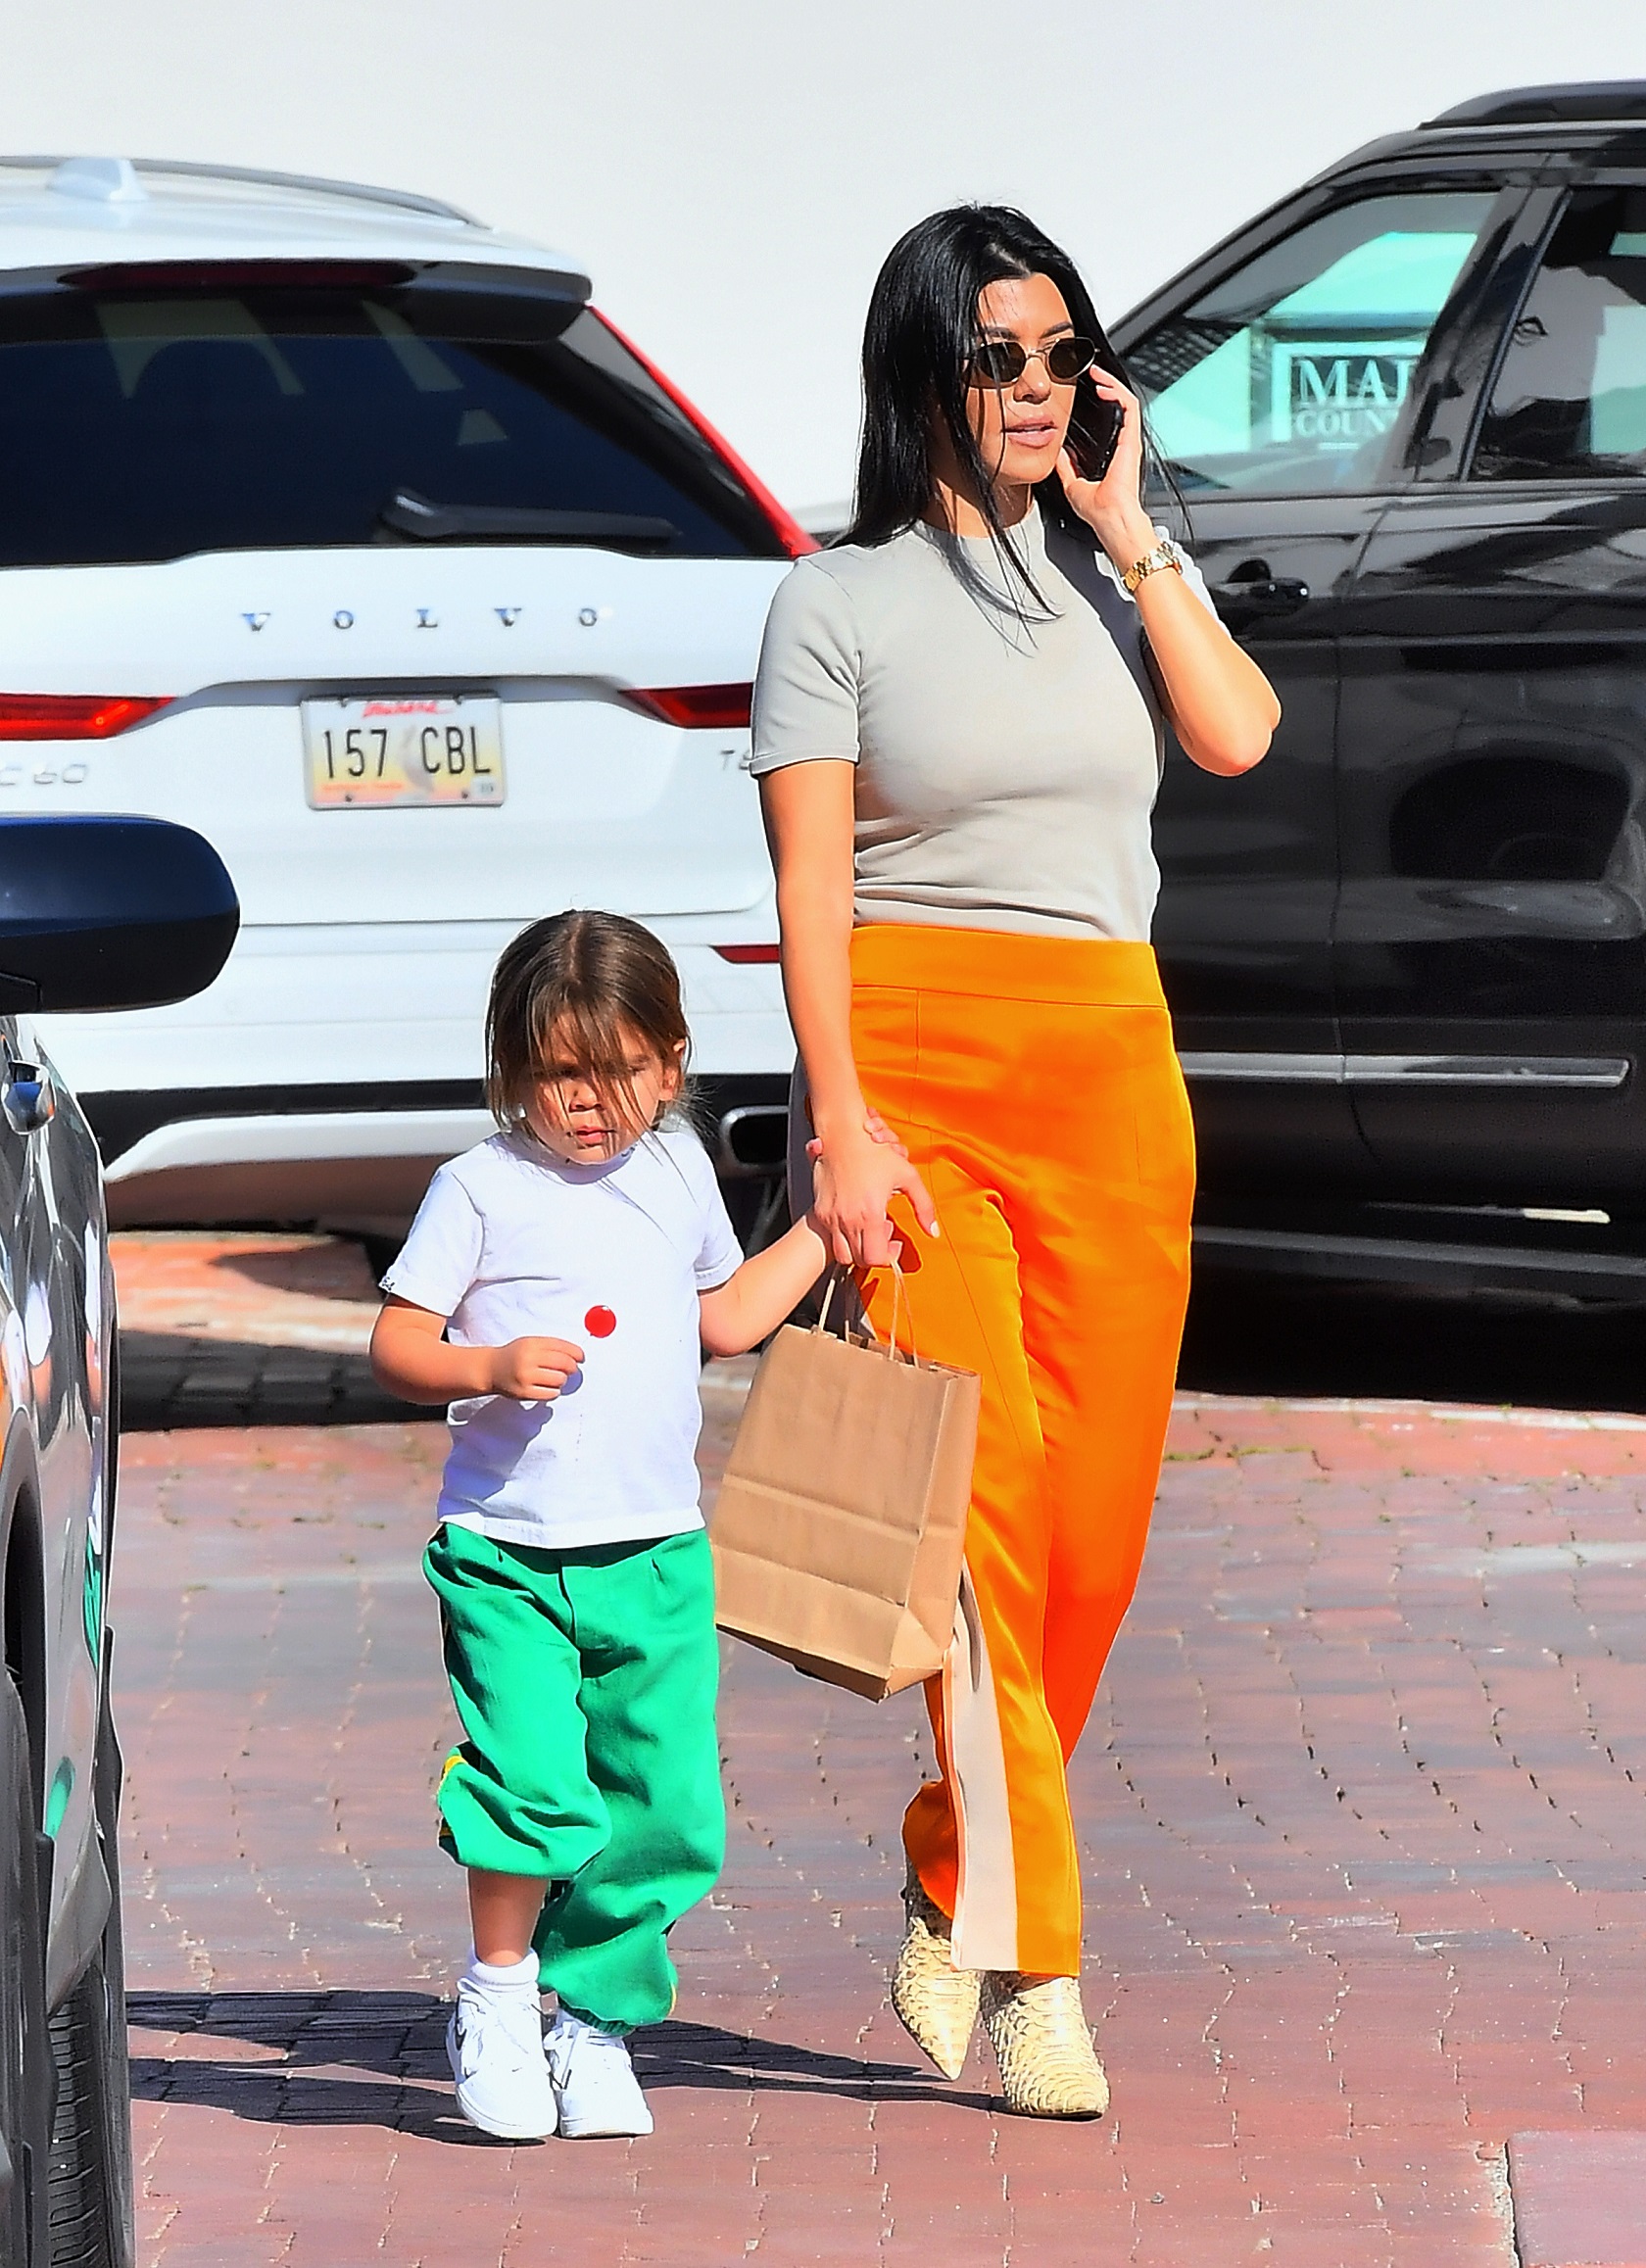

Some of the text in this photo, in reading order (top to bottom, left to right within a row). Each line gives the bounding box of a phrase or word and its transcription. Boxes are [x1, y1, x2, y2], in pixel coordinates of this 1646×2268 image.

[241, 607, 598, 632] VOLVO
[324, 726, 492, 779] 157 CBL
